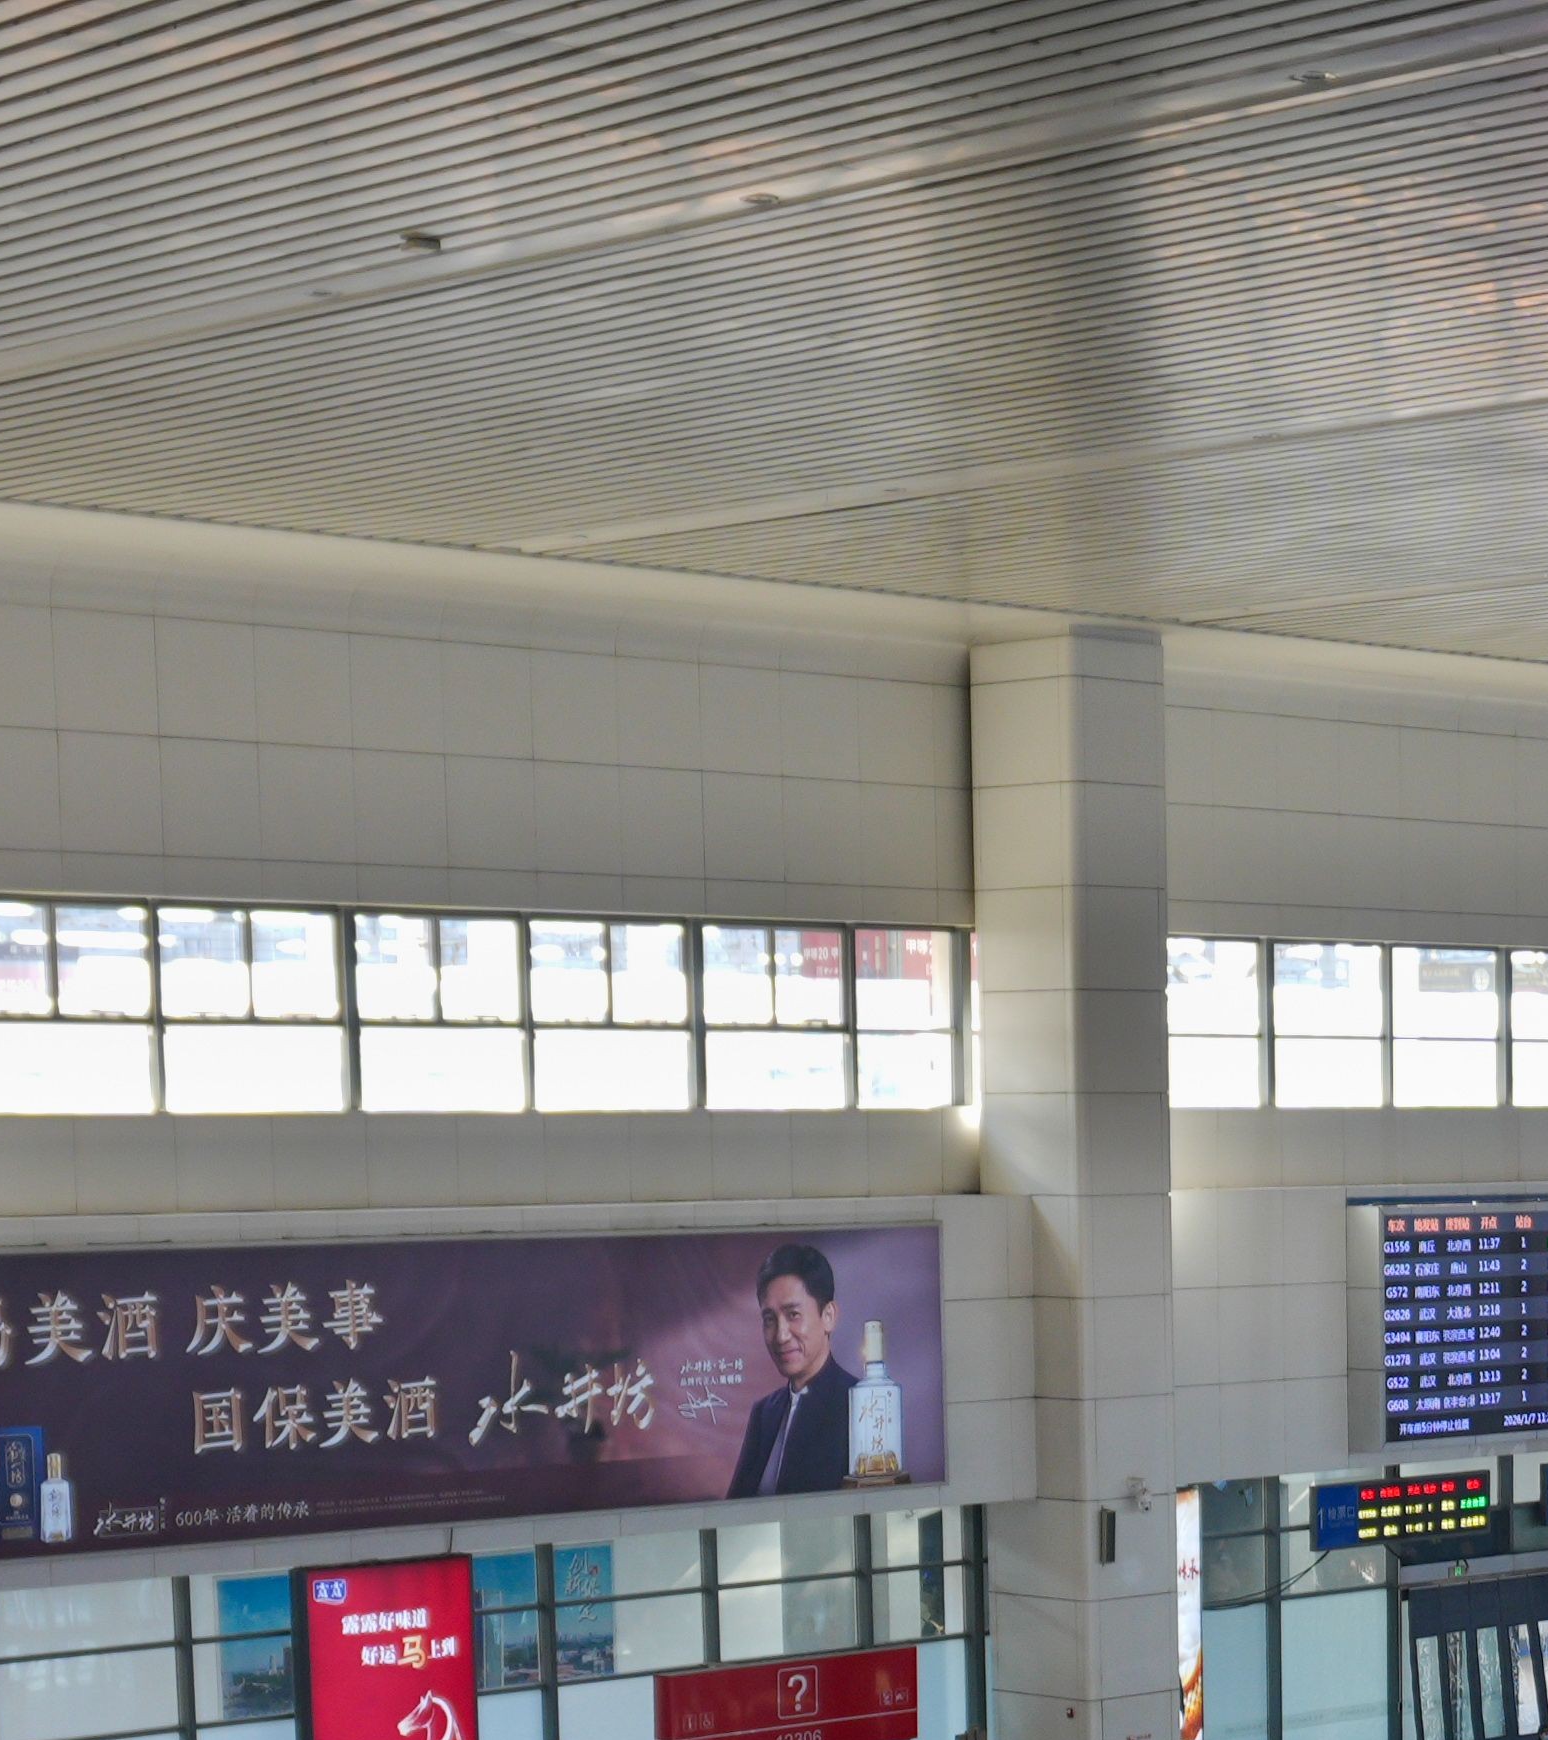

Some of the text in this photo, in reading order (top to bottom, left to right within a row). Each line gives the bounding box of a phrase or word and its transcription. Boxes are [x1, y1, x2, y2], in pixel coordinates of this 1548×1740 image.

[1384, 1241, 1410, 1253] G1556
[1479, 1238, 1500, 1249] 11:37
[186, 1279, 384, 1356] 庆美事
[192, 1376, 437, 1455] 国保美酒
[468, 1349, 654, 1447] 水井坊
[342, 1608, 427, 1635] 露露好味道
[361, 1635, 455, 1669] 好运马上到
